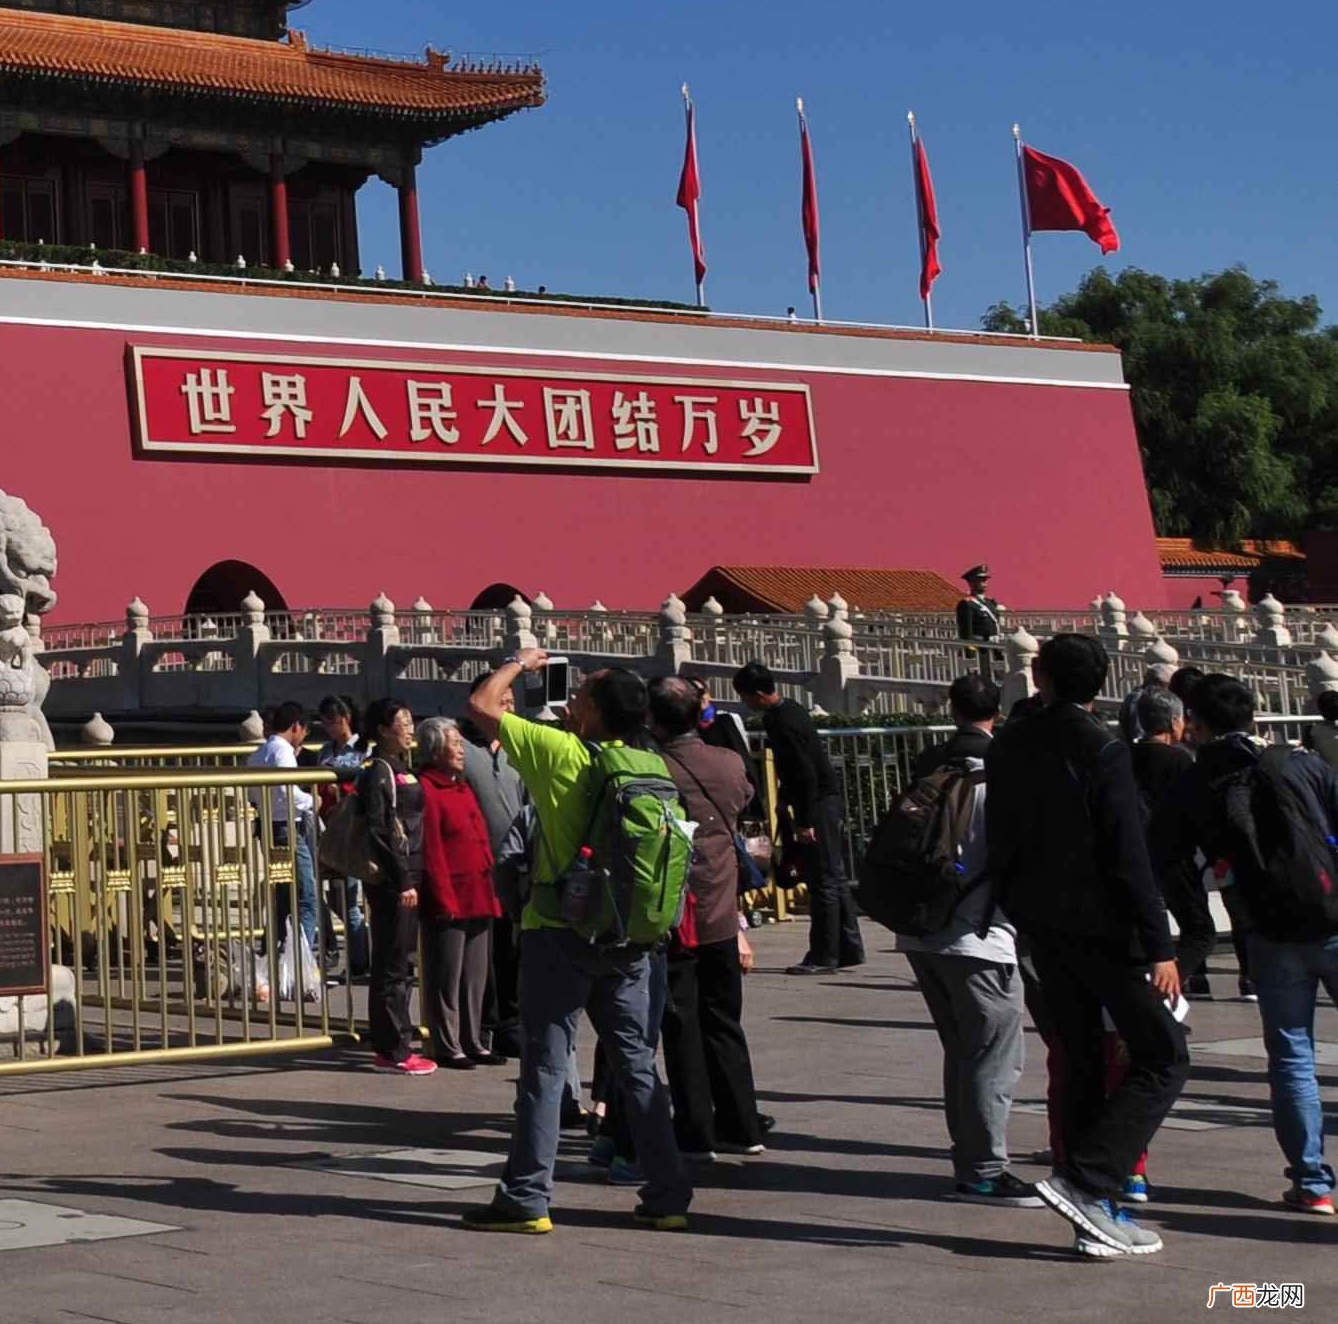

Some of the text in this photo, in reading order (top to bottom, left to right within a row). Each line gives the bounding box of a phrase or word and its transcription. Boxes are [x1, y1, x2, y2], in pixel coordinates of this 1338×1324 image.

[180, 367, 783, 457] 世界人民大团结万岁
